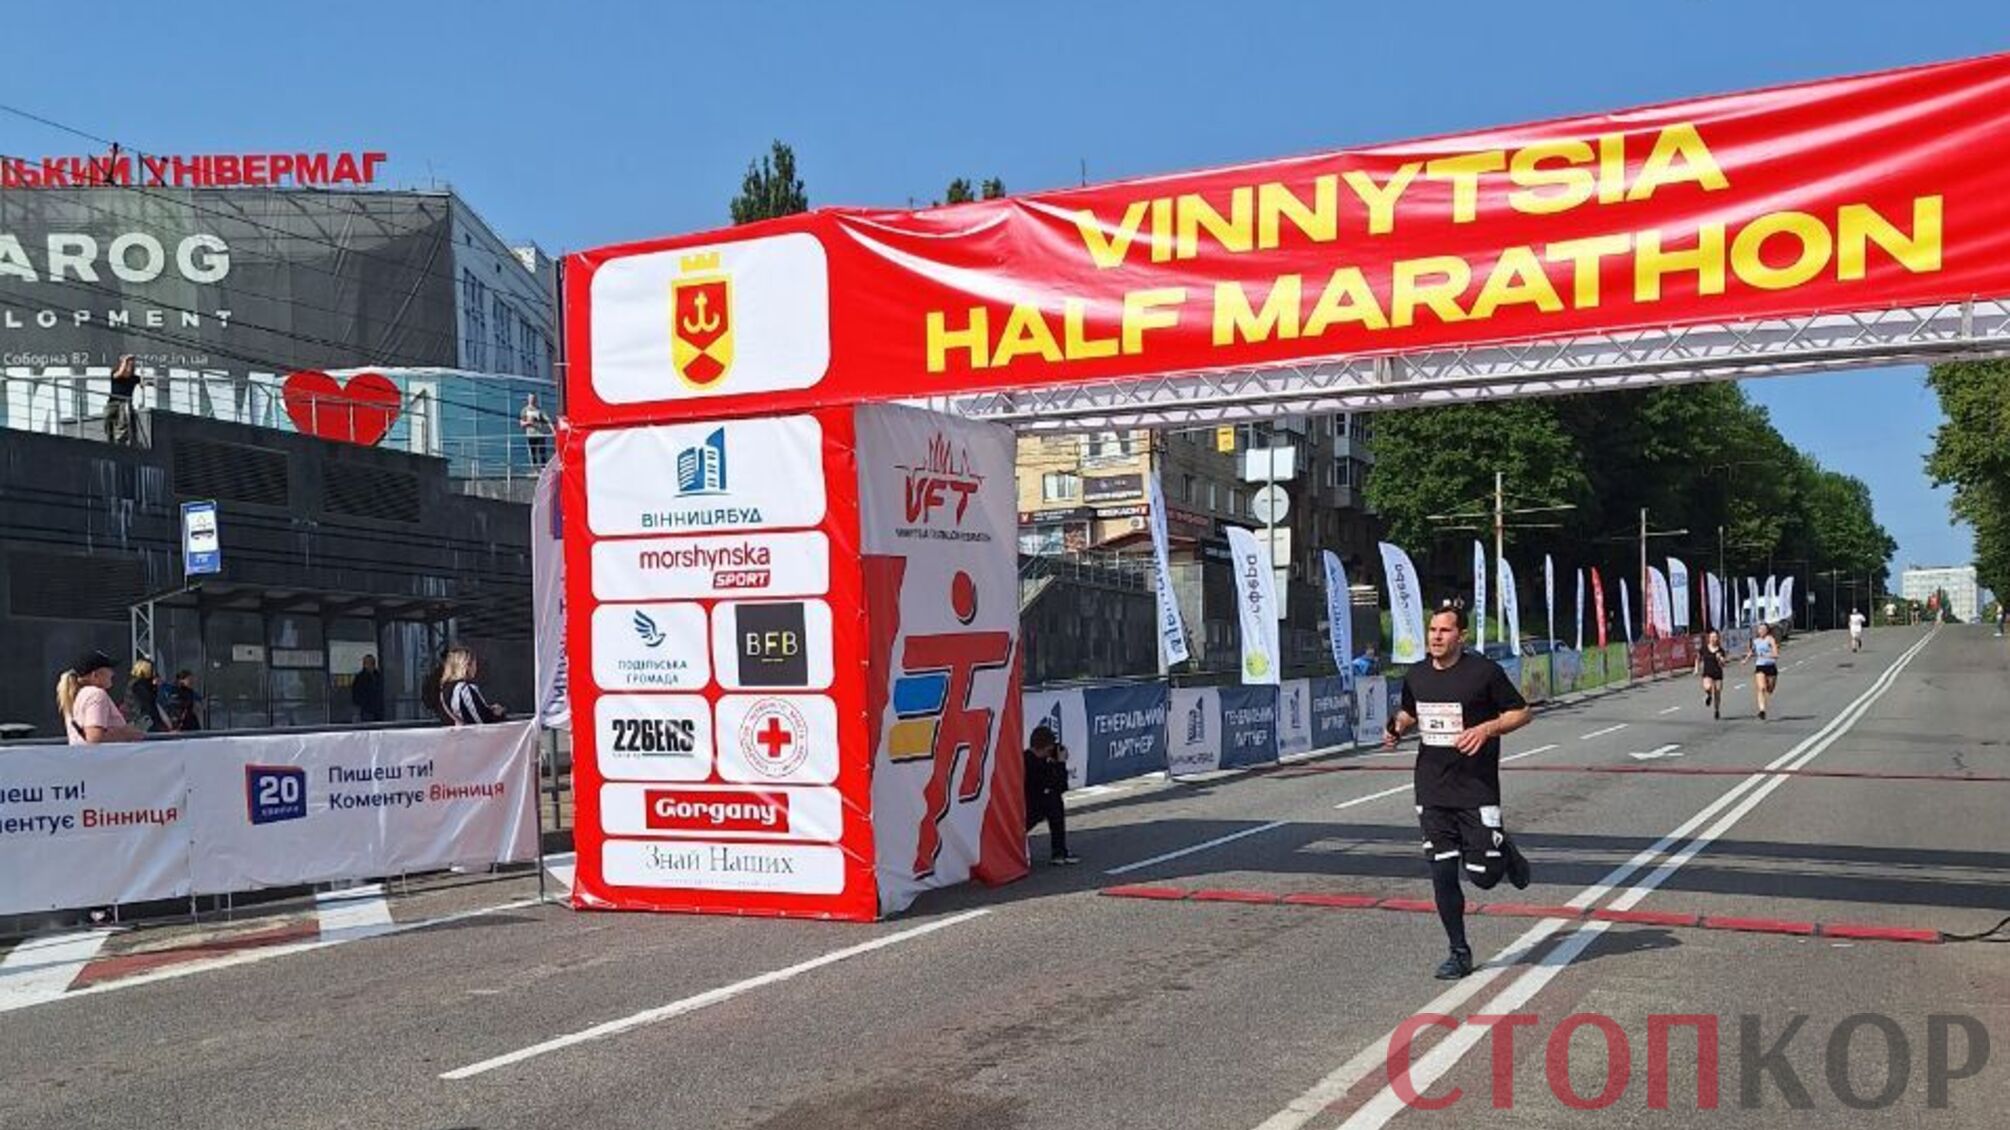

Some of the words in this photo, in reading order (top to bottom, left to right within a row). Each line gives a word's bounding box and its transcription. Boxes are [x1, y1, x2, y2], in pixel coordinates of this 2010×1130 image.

[147, 153, 387, 187] УНІВЕРМАГ
[1078, 123, 1731, 270] VINNYTSIA
[926, 287, 1186, 373] HALF
[1211, 195, 1943, 348] MARATHON
[906, 475, 978, 526] VFT
[641, 507, 762, 528] ВІННИЦЯБУД
[640, 541, 770, 571] morshynska
[715, 572, 768, 587] SPORT
[746, 631, 799, 656] BFB
[612, 719, 695, 752] 226ERS
[329, 765, 401, 783] Пишеш
[407, 760, 433, 777] ти!
[51, 780, 86, 800] ти!
[260, 776, 299, 804] 20
[330, 790, 424, 810] Коментує
[429, 782, 505, 801] Вінниця
[0, 814, 75, 835] ентує
[82, 807, 178, 828] Вінниця
[655, 798, 776, 825] Gorgany
[645, 844, 700, 871] Знай
[709, 846, 795, 874] Наших
